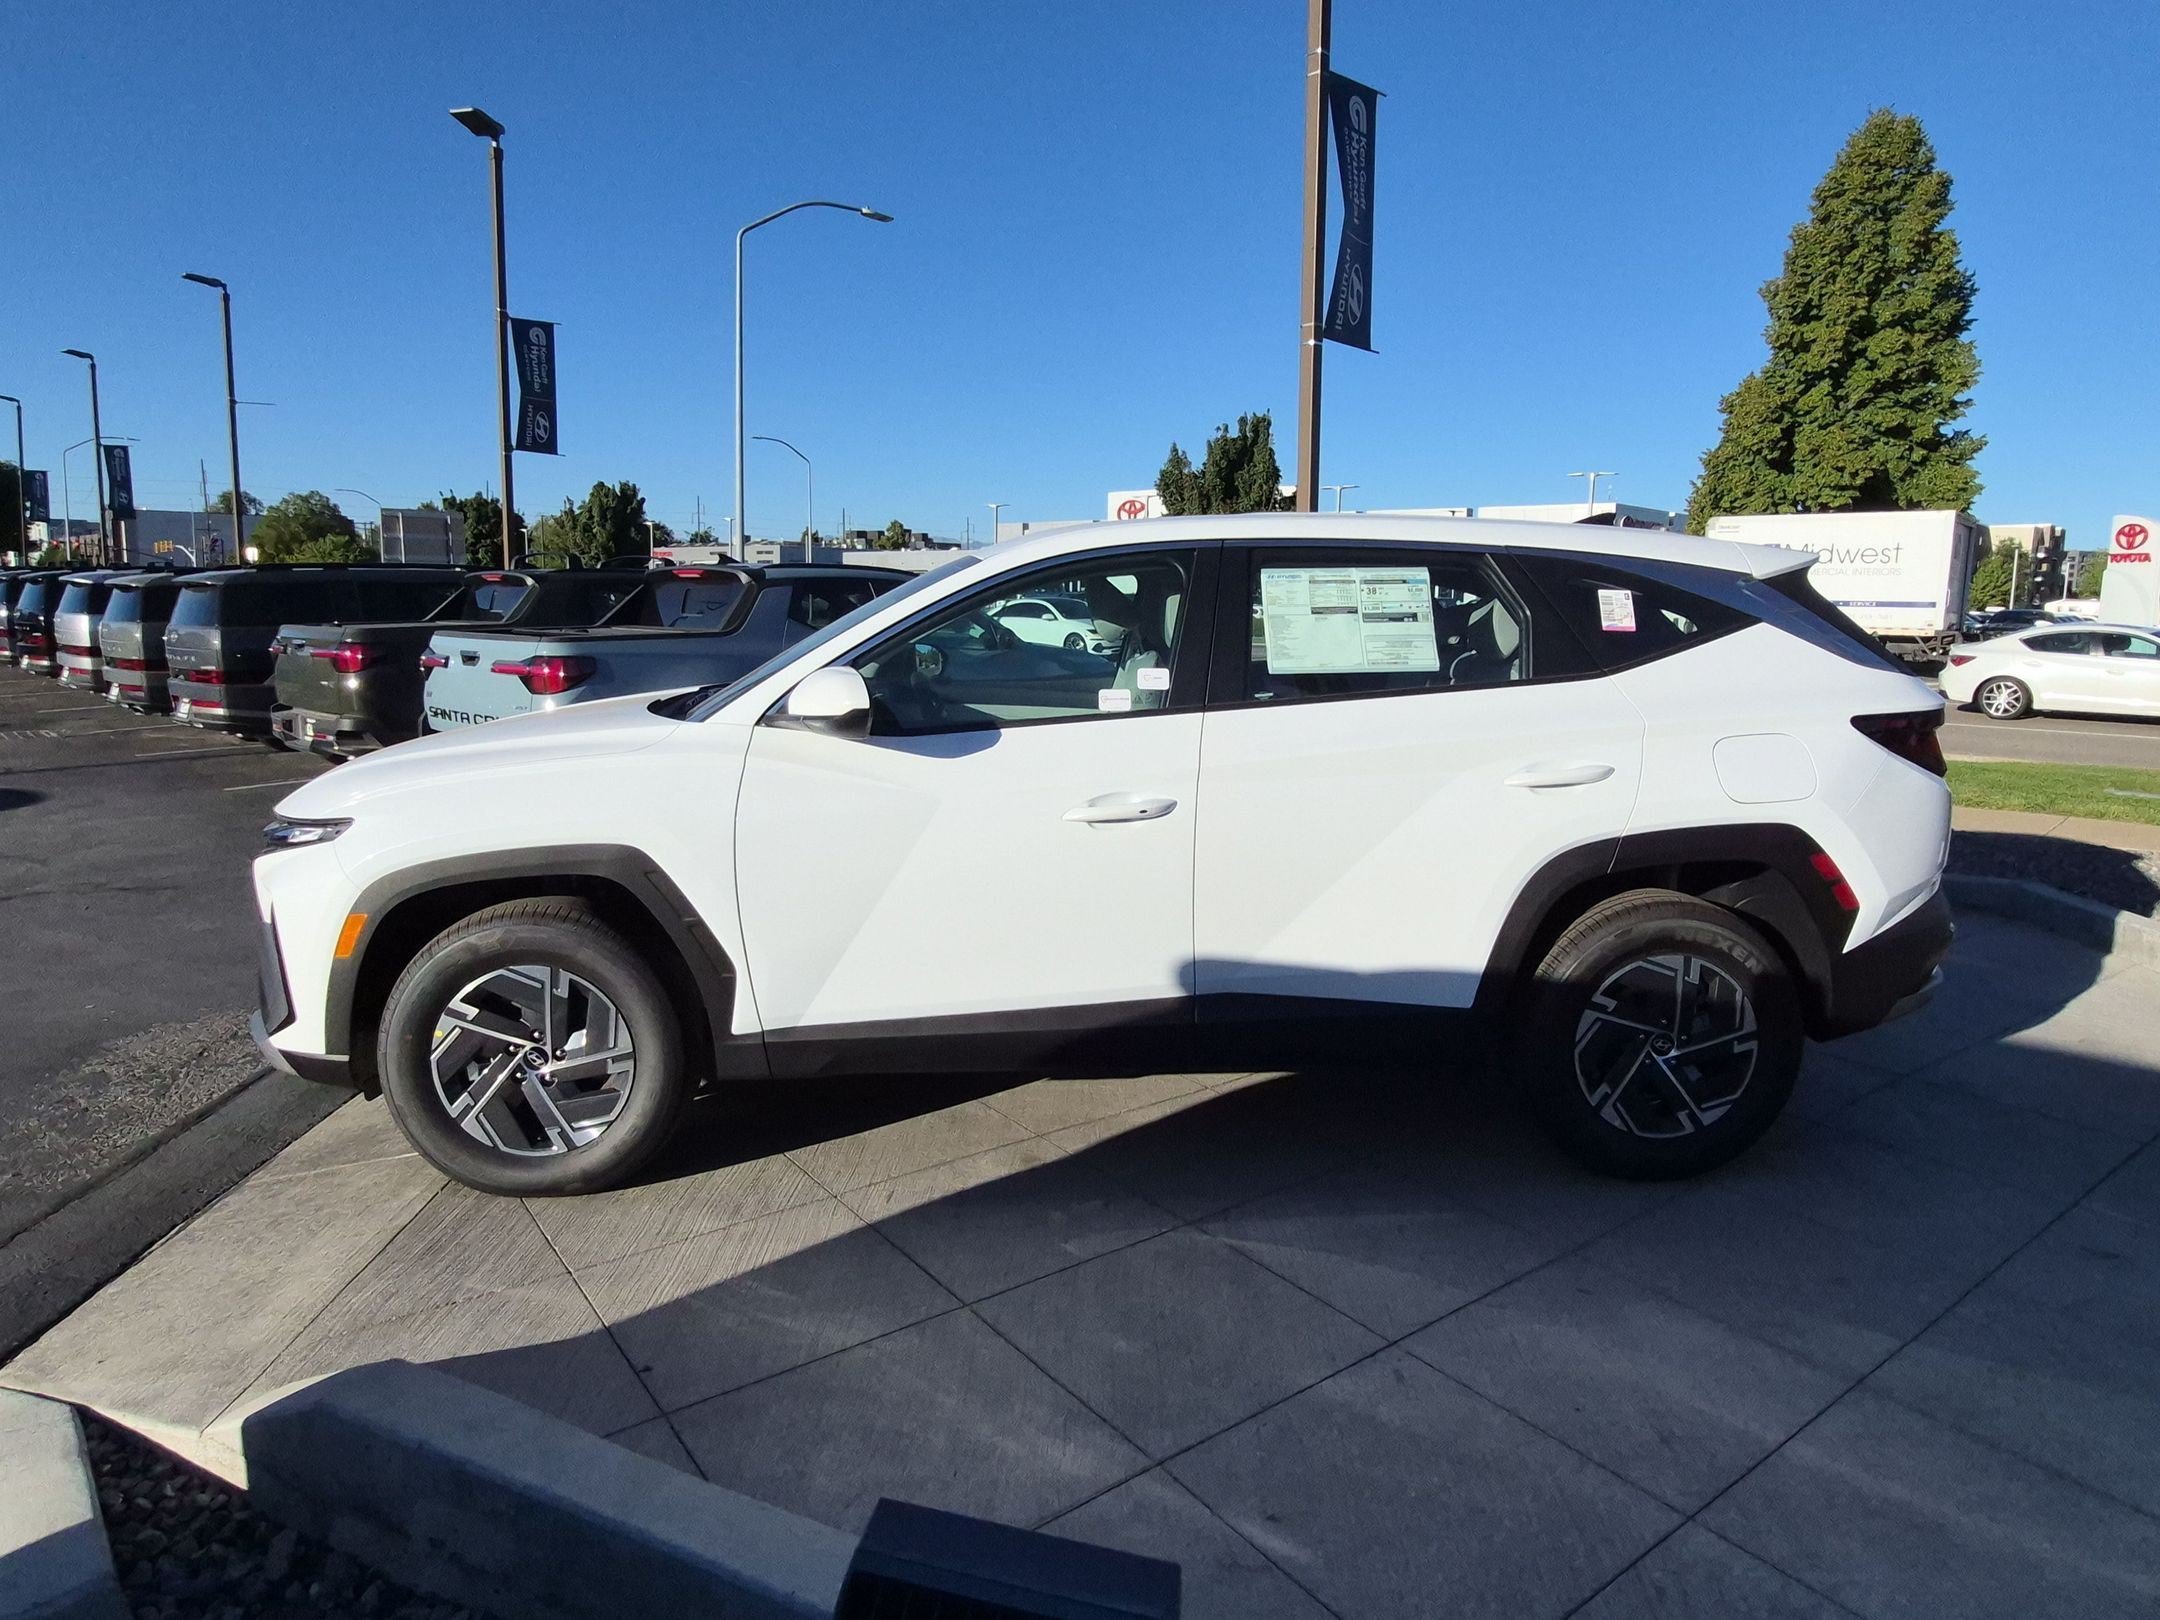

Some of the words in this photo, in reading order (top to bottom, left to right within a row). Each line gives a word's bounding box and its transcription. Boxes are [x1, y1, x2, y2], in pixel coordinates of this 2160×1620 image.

[1351, 131, 1360, 225] Hyundai
[1335, 247, 1351, 331] HYUNDAI
[530, 345, 541, 393] Hyundai
[525, 404, 535, 447] HYUNDAI
[1852, 567, 1902, 577] INTERIORS
[2108, 552, 2151, 563] TOYOTA
[1366, 586, 1377, 595] 38
[429, 705, 471, 724] SANTA
